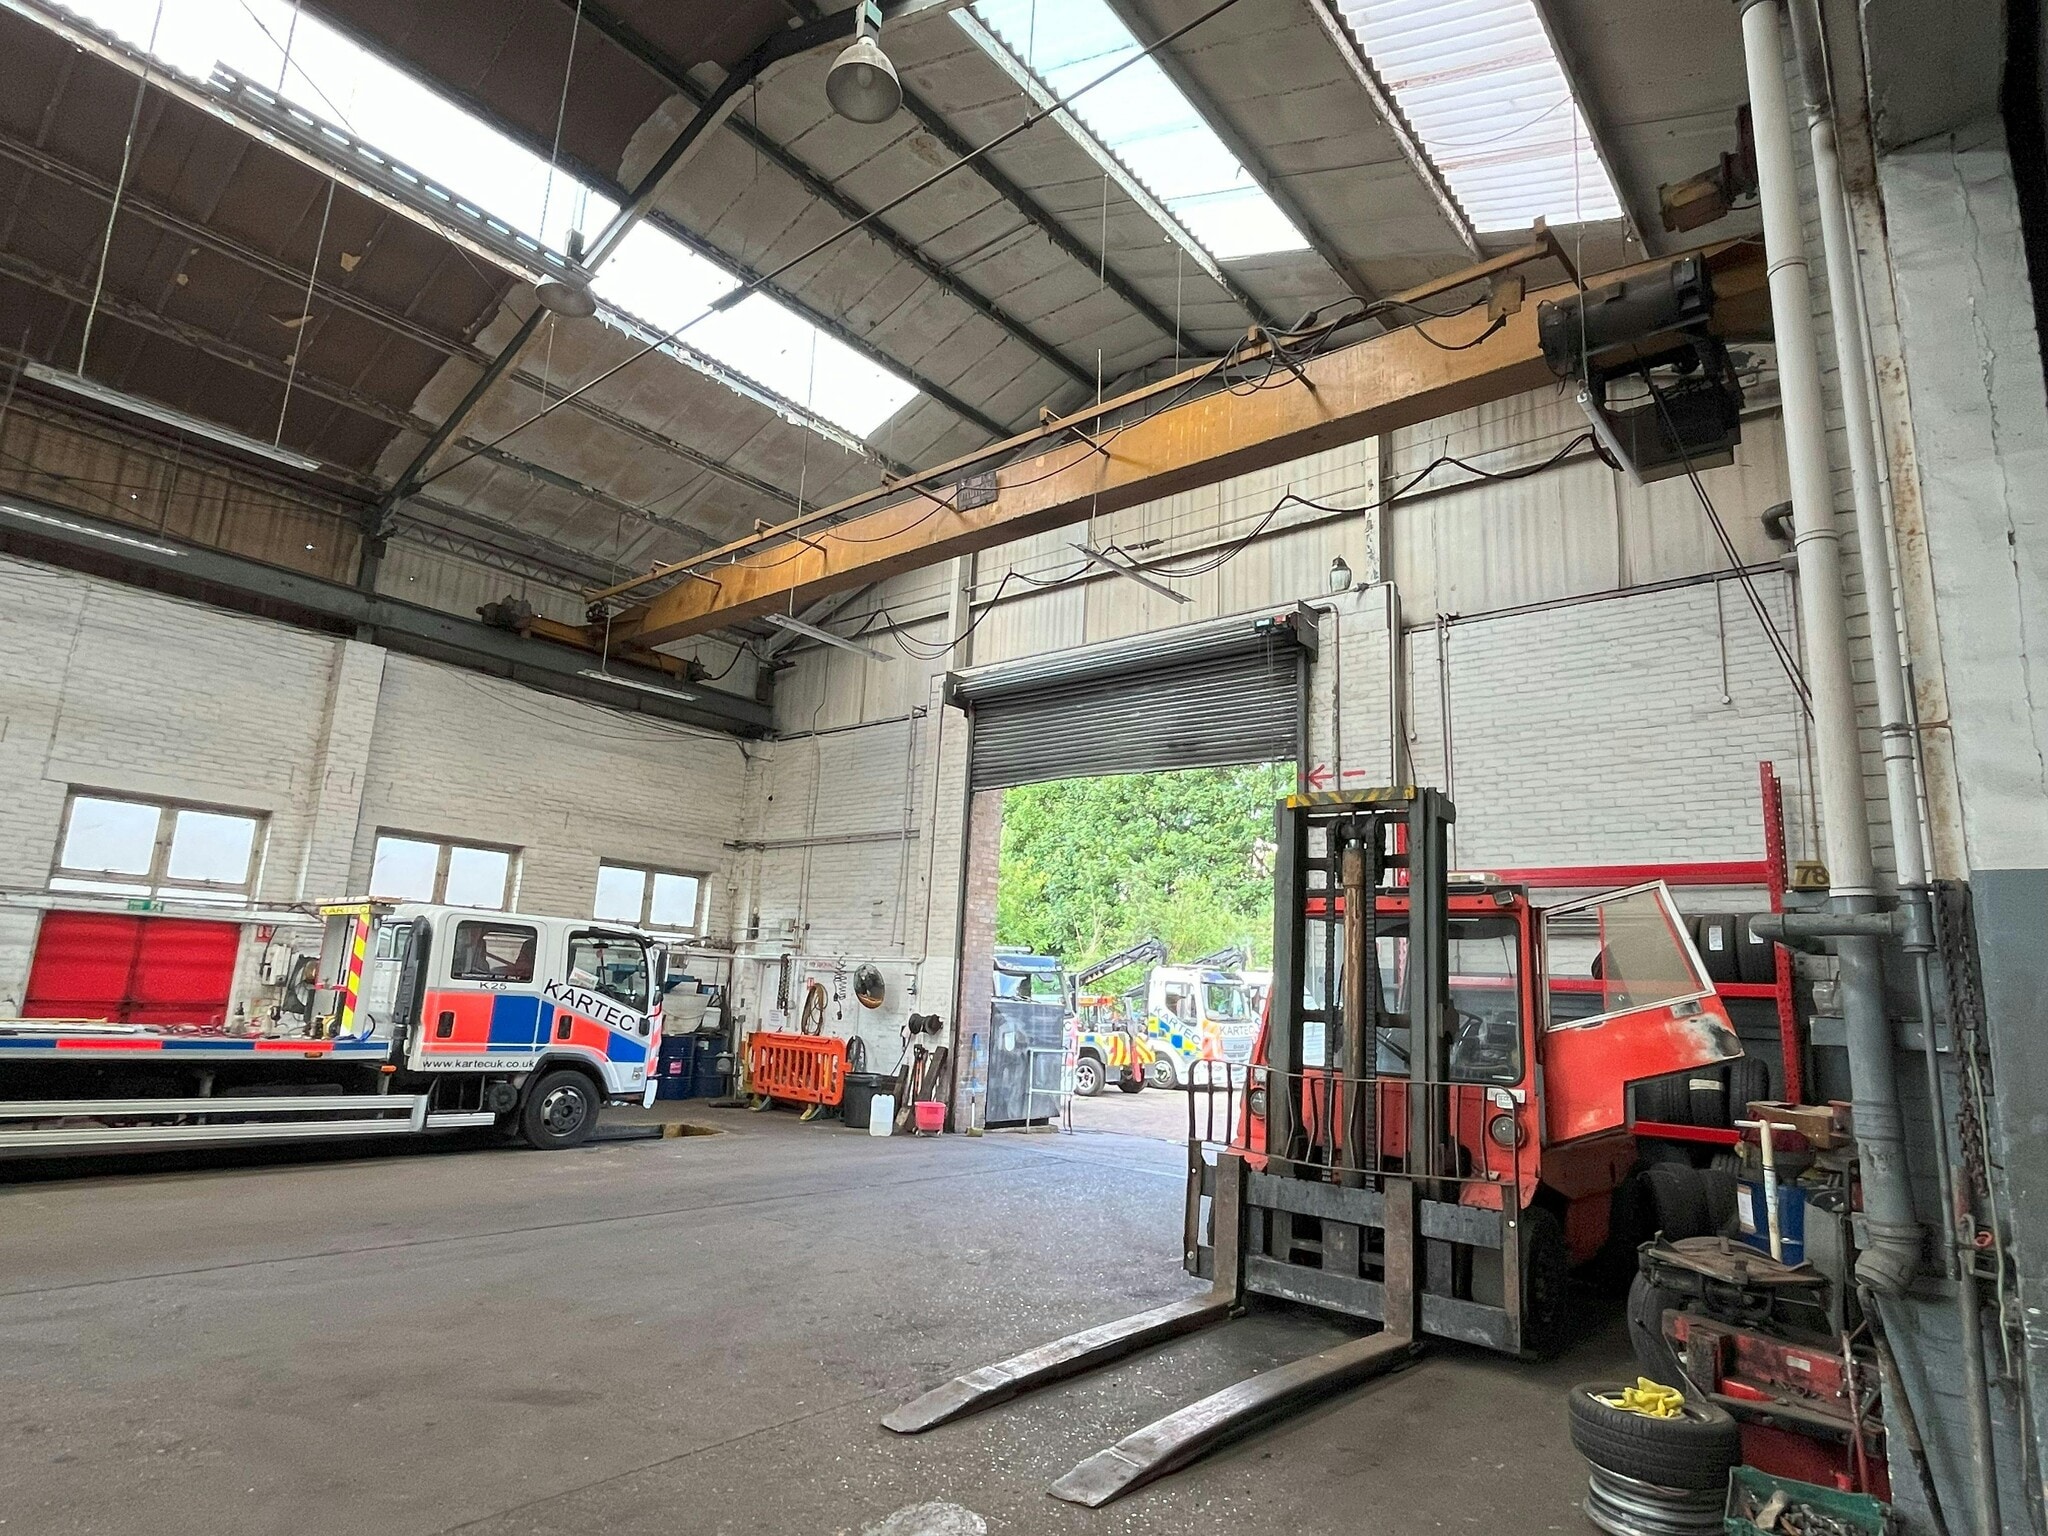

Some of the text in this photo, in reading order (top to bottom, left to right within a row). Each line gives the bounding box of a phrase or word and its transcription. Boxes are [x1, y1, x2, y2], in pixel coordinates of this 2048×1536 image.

[321, 905, 368, 914] KARTEC
[480, 982, 507, 990] K25
[543, 978, 635, 1031] KARTEC
[1154, 1005, 1201, 1045] KARTEC
[1219, 1025, 1255, 1036] KARTEC
[422, 1059, 535, 1069] www.kartecuk.co.uk
